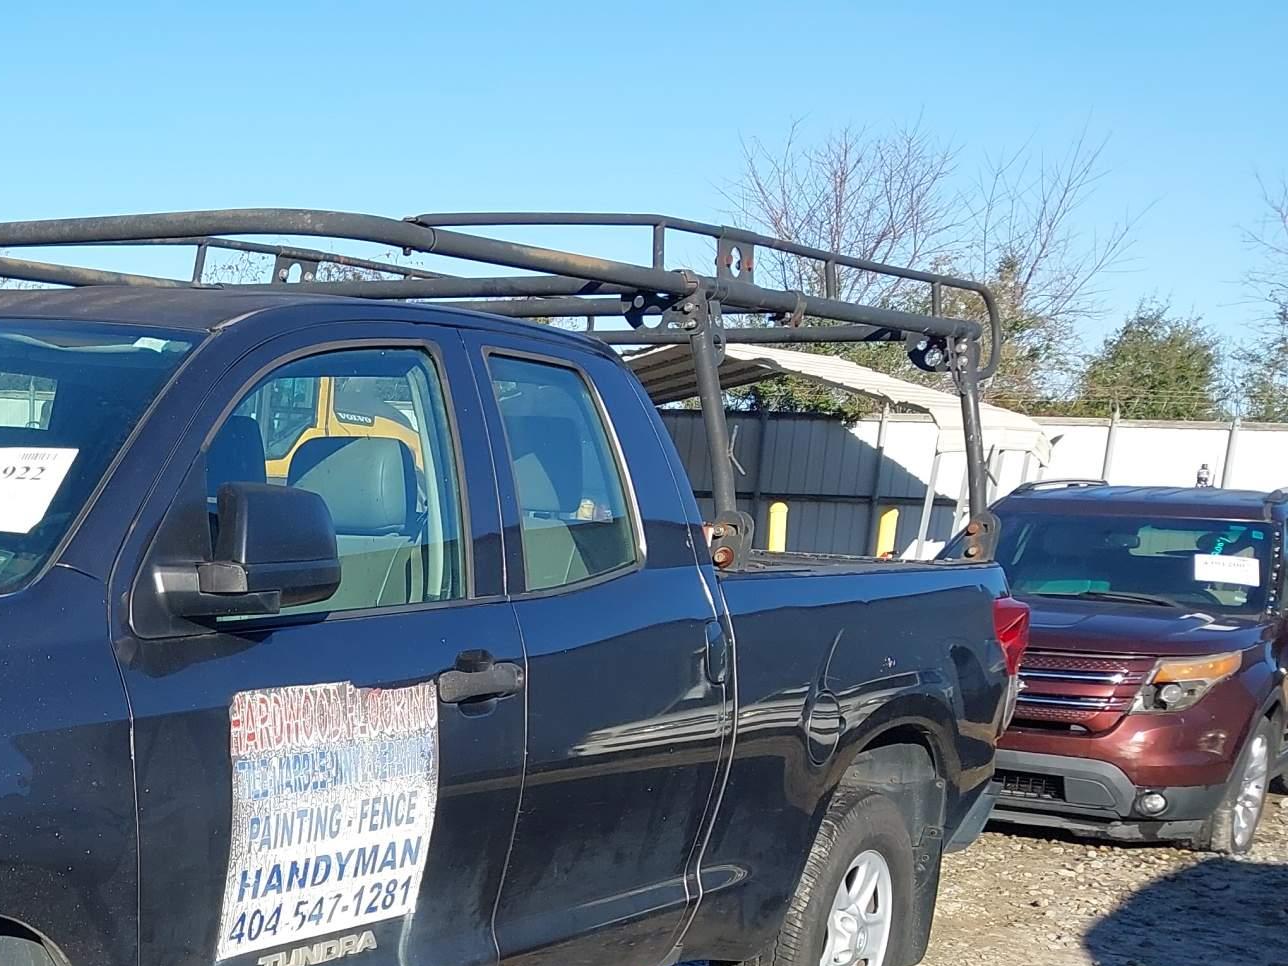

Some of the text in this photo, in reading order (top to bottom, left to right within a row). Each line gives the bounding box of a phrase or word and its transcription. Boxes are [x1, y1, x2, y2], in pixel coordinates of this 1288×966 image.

[335, 412, 372, 424] VOLVO
[231, 682, 437, 755] HARDWOOD FLOORING
[247, 804, 342, 853] PAINTING
[358, 790, 418, 834] FENCE
[237, 836, 422, 903] HANDYMAN
[228, 875, 412, 945] 404-547-1281
